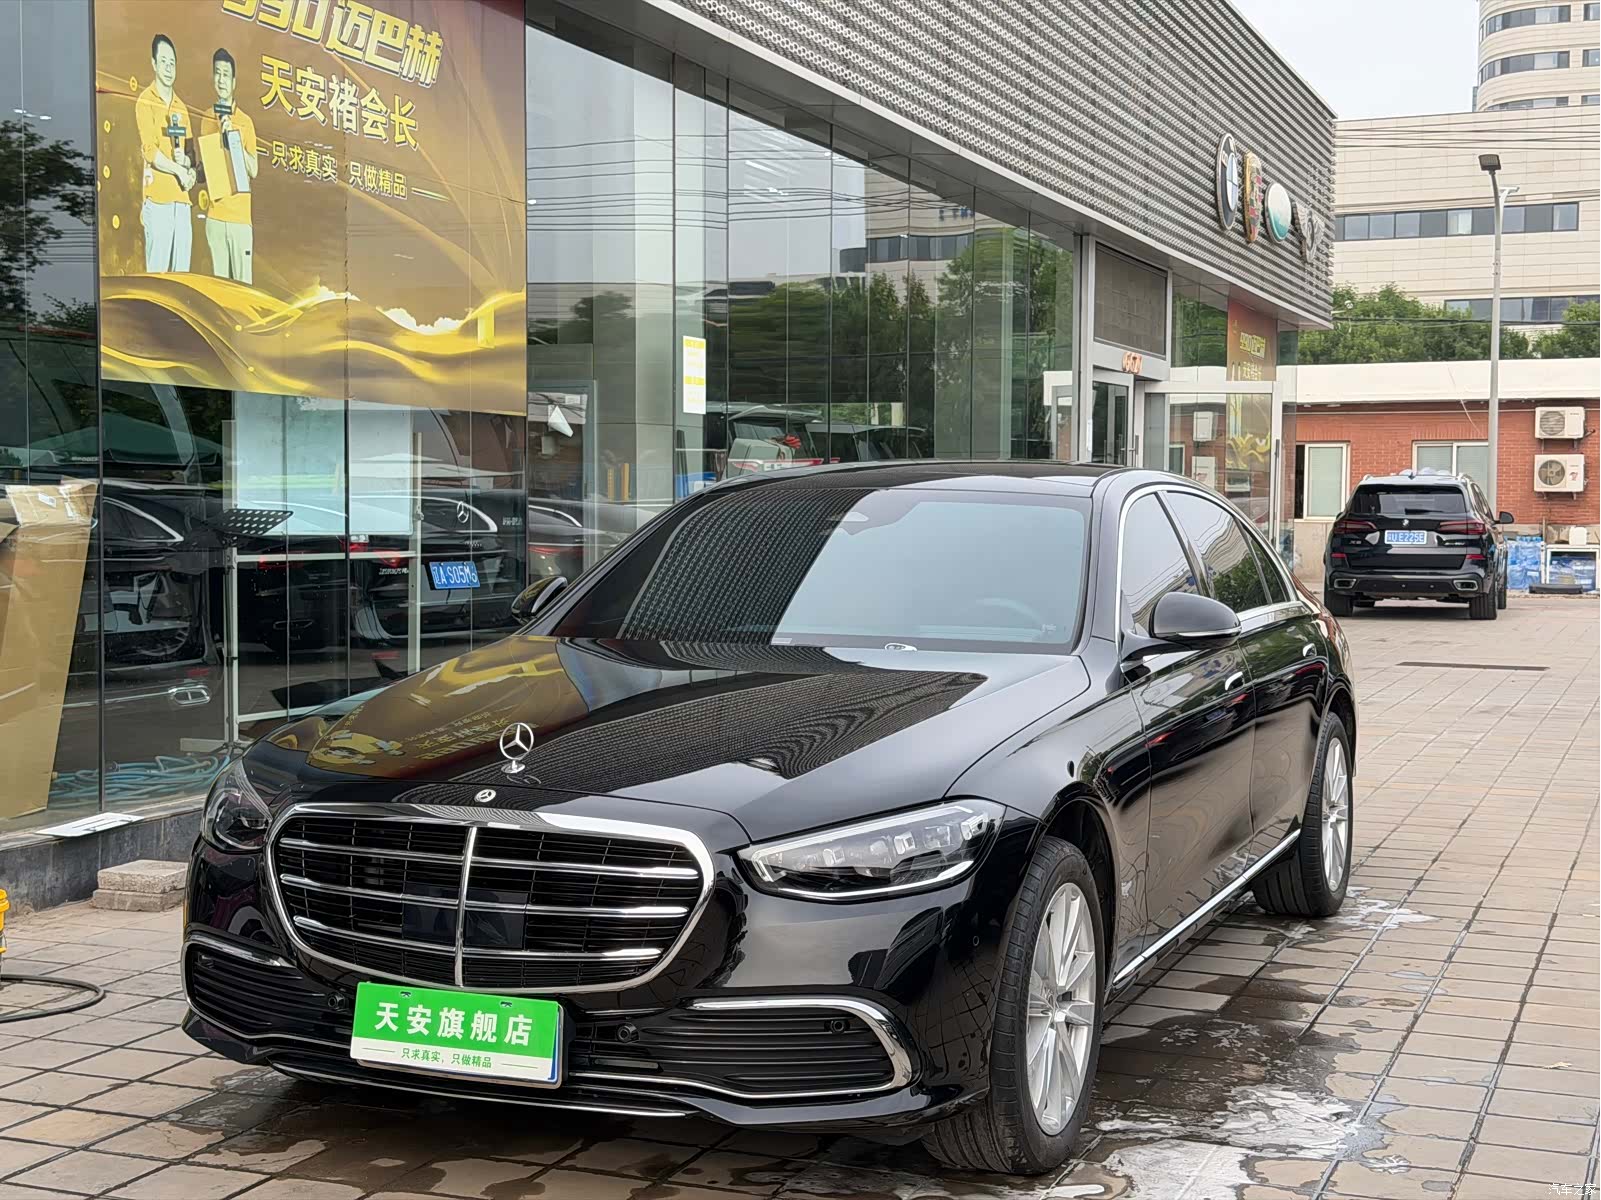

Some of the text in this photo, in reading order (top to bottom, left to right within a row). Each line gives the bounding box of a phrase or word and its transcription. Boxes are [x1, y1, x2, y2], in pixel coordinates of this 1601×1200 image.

[260, 54, 420, 150] 天安褚会长
[271, 141, 408, 199] 只求真实 只做精品
[375, 1001, 533, 1046] 天安旗舰店
